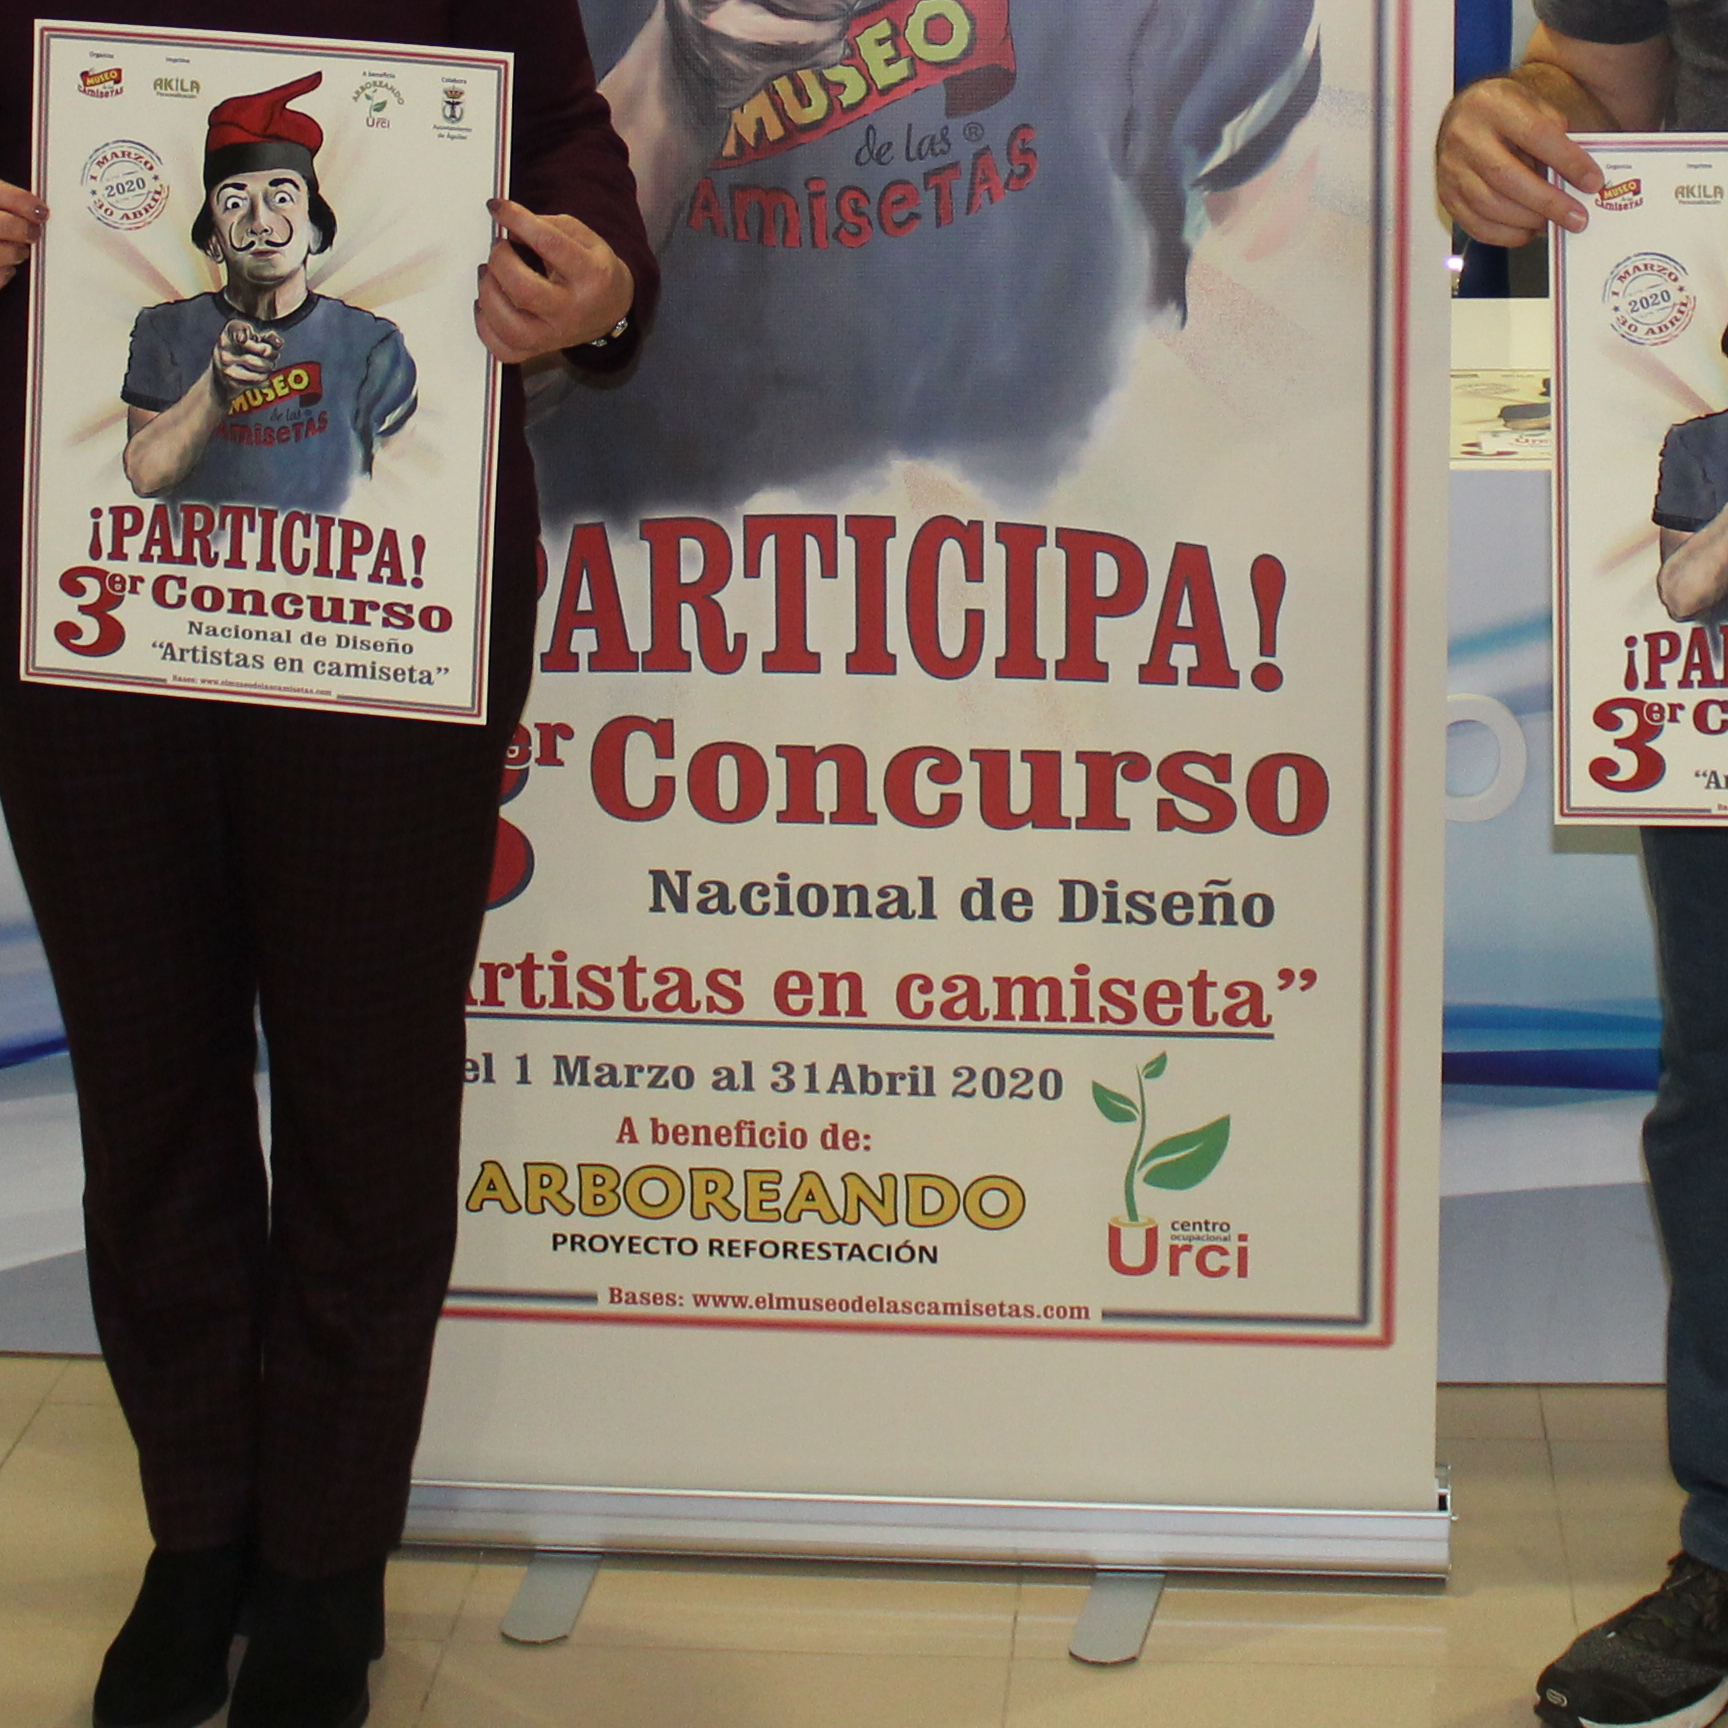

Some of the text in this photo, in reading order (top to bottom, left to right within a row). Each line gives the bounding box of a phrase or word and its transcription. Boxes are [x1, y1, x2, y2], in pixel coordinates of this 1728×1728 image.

[153, 77, 201, 94] AKILA
[95, 150, 154, 171] MARZO
[855, 123, 951, 167] de las
[93, 183, 163, 220] 30 ABRIL
[105, 177, 146, 198] 2020
[1675, 183, 1724, 200] AKILA
[1616, 263, 1680, 284] MARZO
[1616, 294, 1691, 336] 30 ABRIL
[1628, 289, 1672, 314] 2020
[227, 368, 310, 415] MUSEO
[88, 503, 426, 589] ¡PARTICIPA!
[151, 573, 453, 633] Concurso
[536, 514, 1288, 693] ARTICIPA!
[188, 620, 414, 655] Nacional de Diseño
[152, 640, 265, 670] “Artistas
[274, 656, 304, 674] en
[314, 658, 450, 686] camiseta”
[590, 714, 1330, 836] Concurso
[648, 869, 1276, 928] Nacional de Diseño
[773, 969, 868, 1018] en
[895, 963, 1319, 1028] camiseta”
[516, 1053, 531, 1086] 1
[553, 1054, 695, 1091] Marzo
[711, 1060, 755, 1093] al
[950, 1066, 1064, 1101] 2020
[616, 1116, 873, 1152] A beneficio de:
[465, 1160, 1027, 1231] ARBOREANDO
[1171, 1219, 1231, 1232] centro
[552, 1234, 939, 1265] PROYECTO REFORESTACIÓN
[1107, 1216, 1250, 1279] Urci
[608, 1287, 1091, 1321] Bases: www.elmuseodelascamisetas.com
